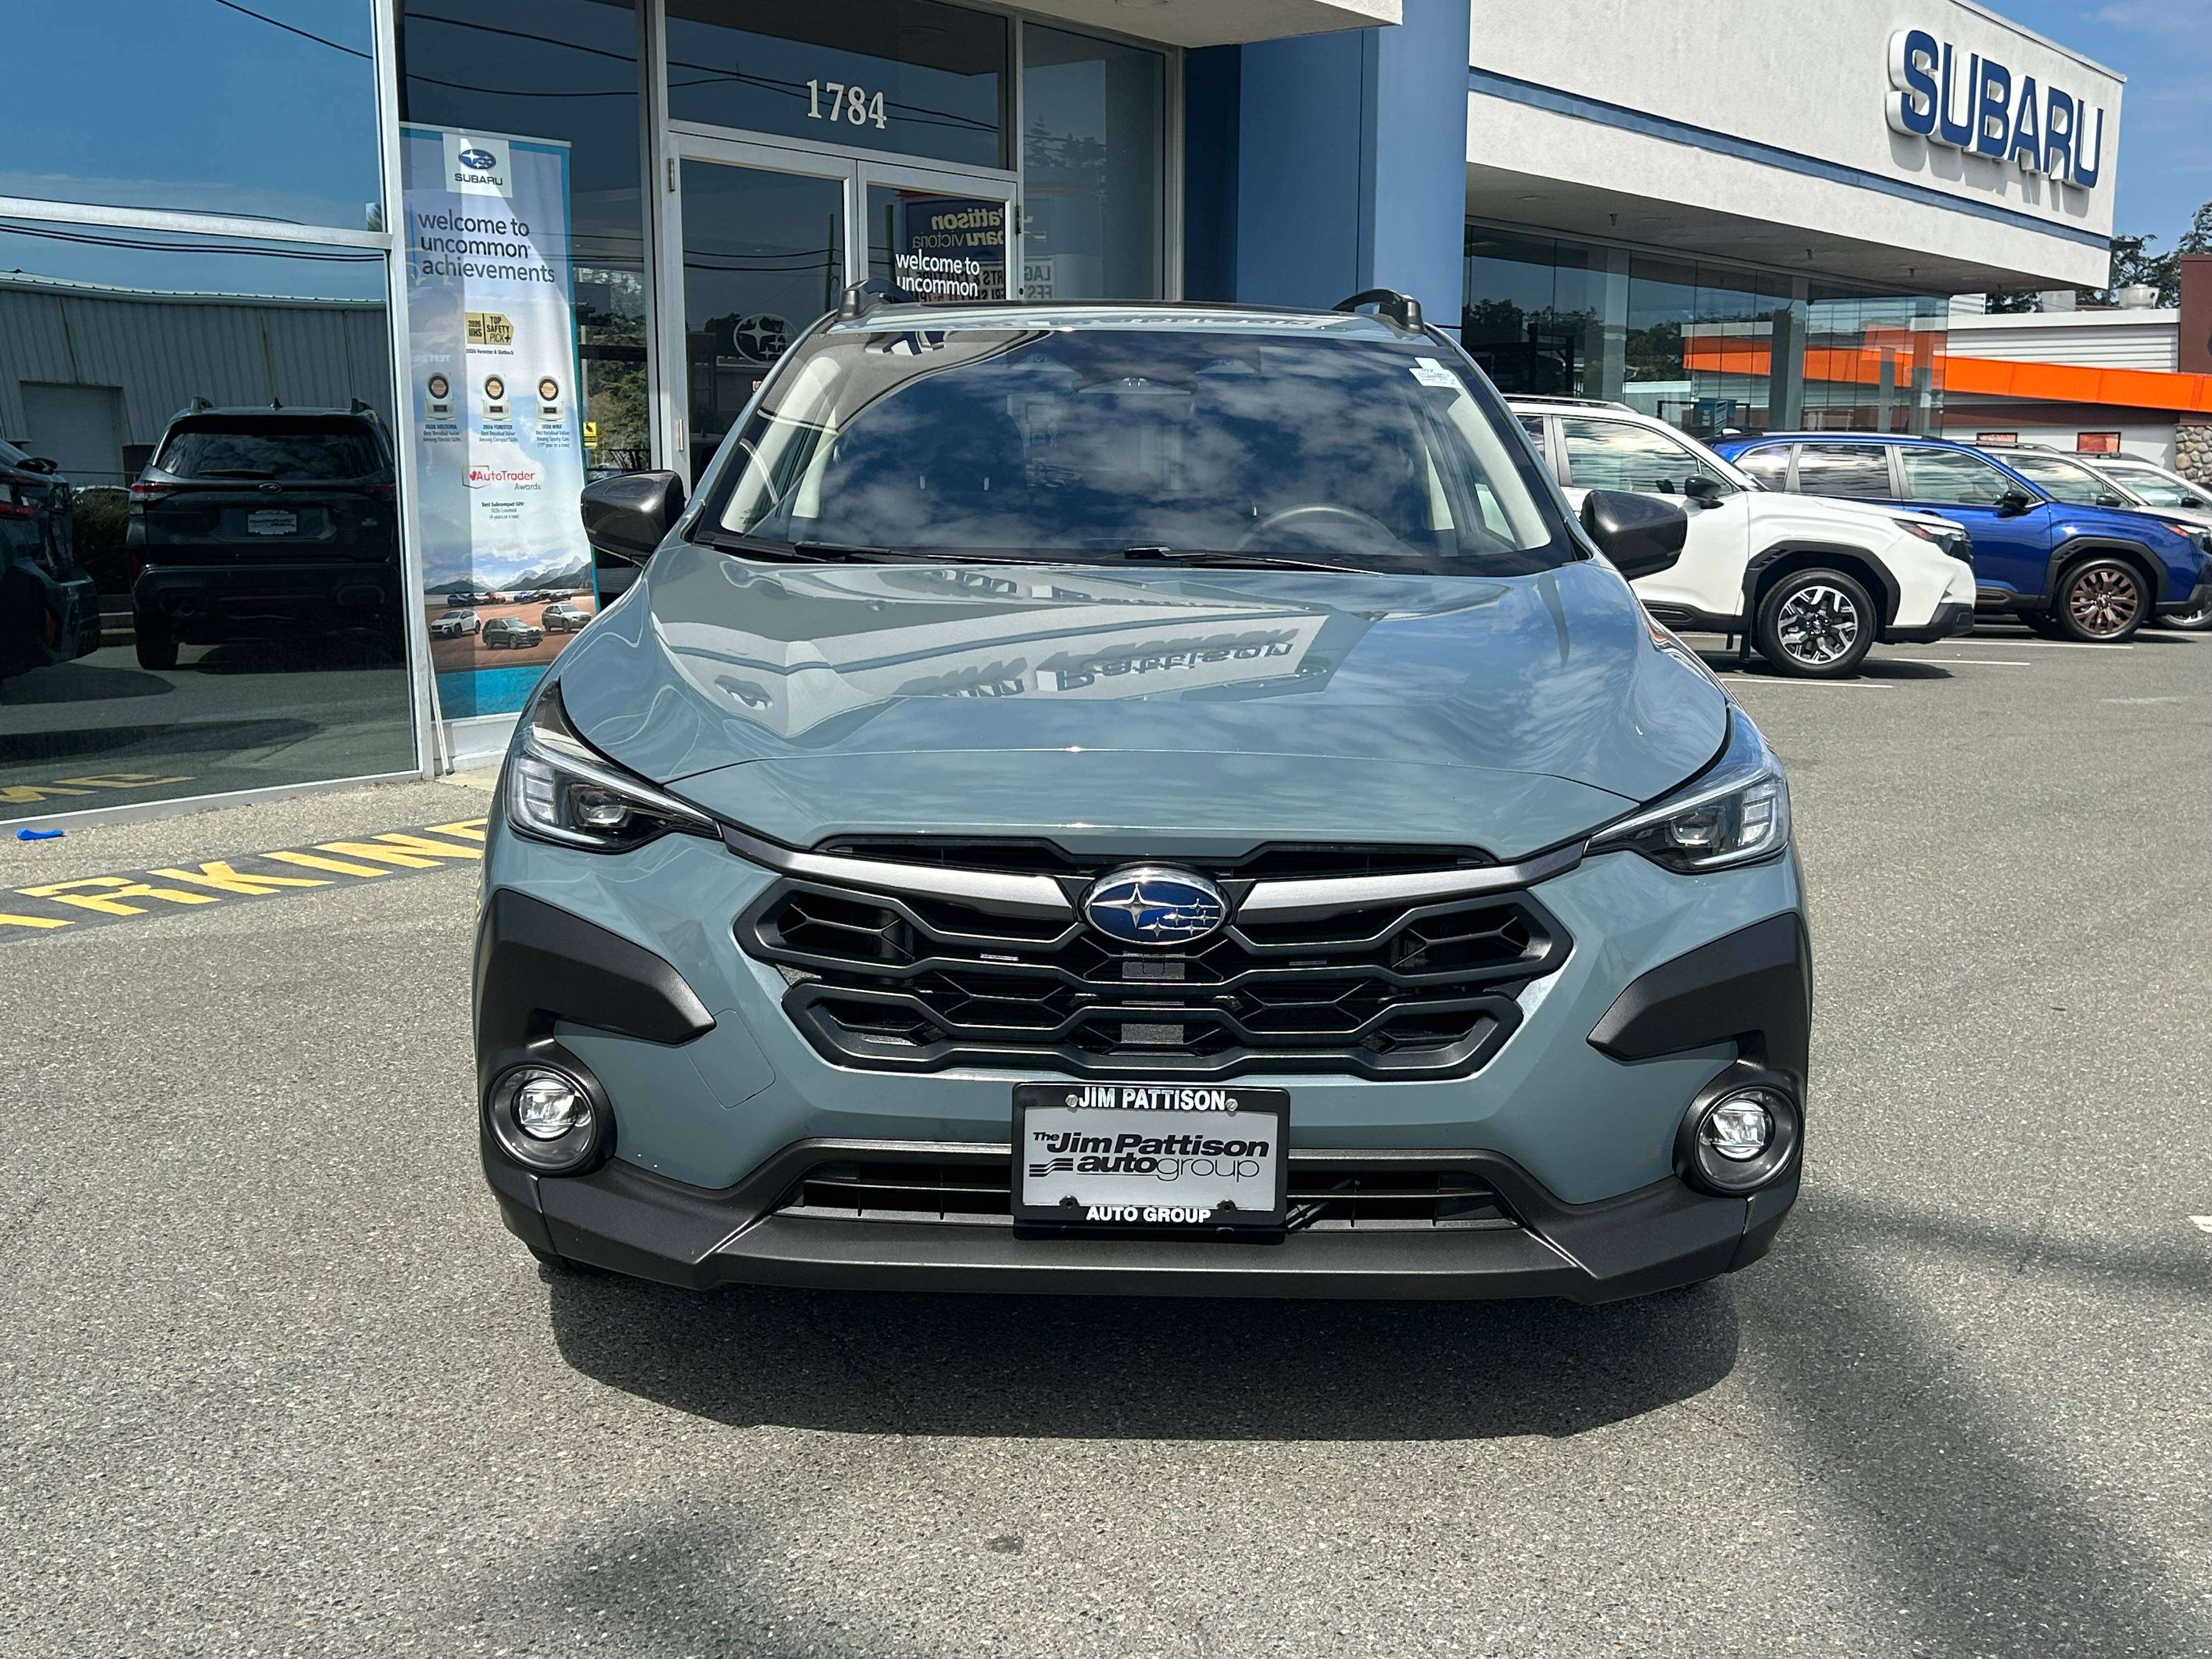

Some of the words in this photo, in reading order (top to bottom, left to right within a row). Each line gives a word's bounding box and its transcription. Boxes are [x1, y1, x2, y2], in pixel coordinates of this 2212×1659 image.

[805, 79, 888, 129] 1784
[1898, 30, 2104, 188] SUBARU
[454, 173, 504, 186] SUBARU
[417, 208, 506, 235] welcome
[510, 219, 529, 237] to
[421, 235, 529, 259] uncommon
[422, 253, 555, 283] achievements
[895, 249, 962, 274] welcome
[965, 257, 980, 275] to
[896, 276, 979, 297] uncommon
[487, 324, 510, 334] SAFETY
[489, 316, 501, 324] TOP
[476, 470, 535, 481] AutoTrader
[1079, 1087, 1115, 1108] JIM
[1122, 1088, 1225, 1111] PATTISON
[1033, 1132, 1059, 1142] The
[1047, 1132, 1112, 1154] Jim
[1114, 1133, 1269, 1157] Pattison
[1086, 1206, 1140, 1222] AUTO
[1143, 1206, 1211, 1223] GROUP
